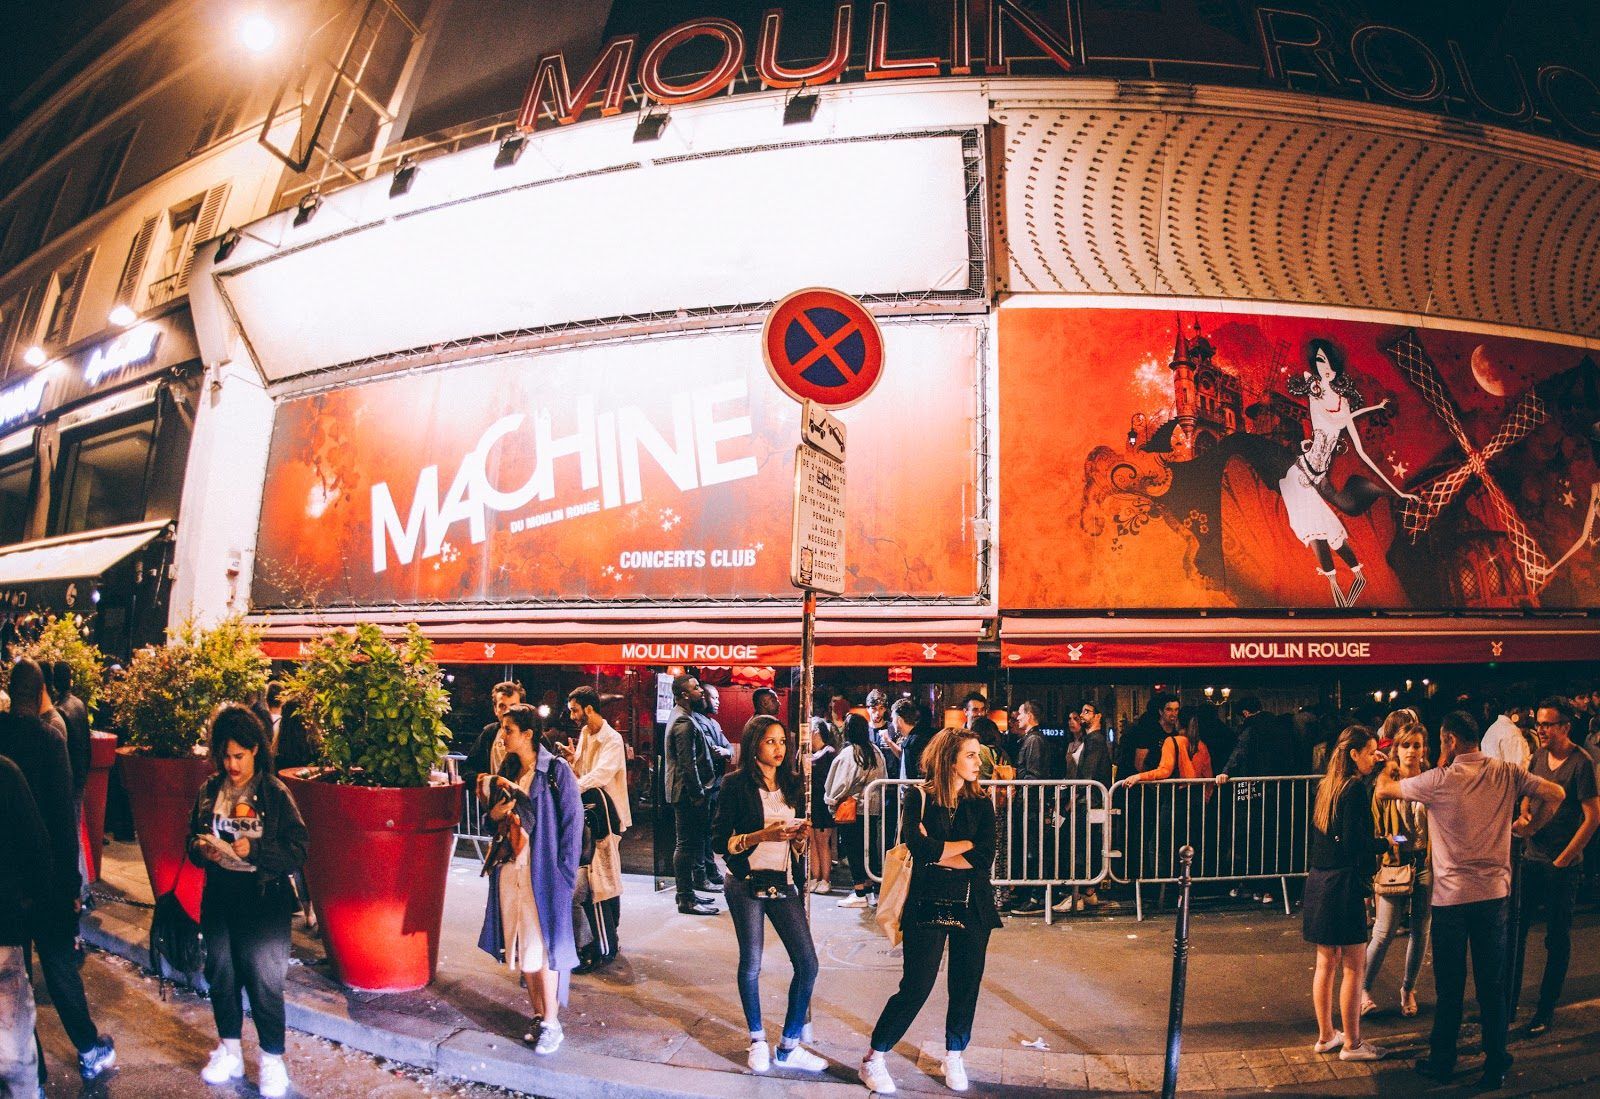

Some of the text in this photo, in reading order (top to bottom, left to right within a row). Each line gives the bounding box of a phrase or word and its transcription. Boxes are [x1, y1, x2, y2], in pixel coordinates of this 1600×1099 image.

[516, 0, 1088, 132] MOULIN
[804, 447, 817, 459] SAUF
[802, 459, 809, 468] DE
[371, 380, 759, 573] MACHINE
[801, 494, 807, 503] DE
[808, 485, 840, 505] DE TOURISME
[510, 499, 601, 534] DU MOULIN ROUGE
[812, 511, 834, 525] PENDANT
[811, 522, 836, 537] LA DURÉE
[619, 549, 757, 569] CONCERTS CLUB
[621, 643, 758, 660] MOULIN ROUGE
[1230, 642, 1371, 660] MOULIN ROUGE
